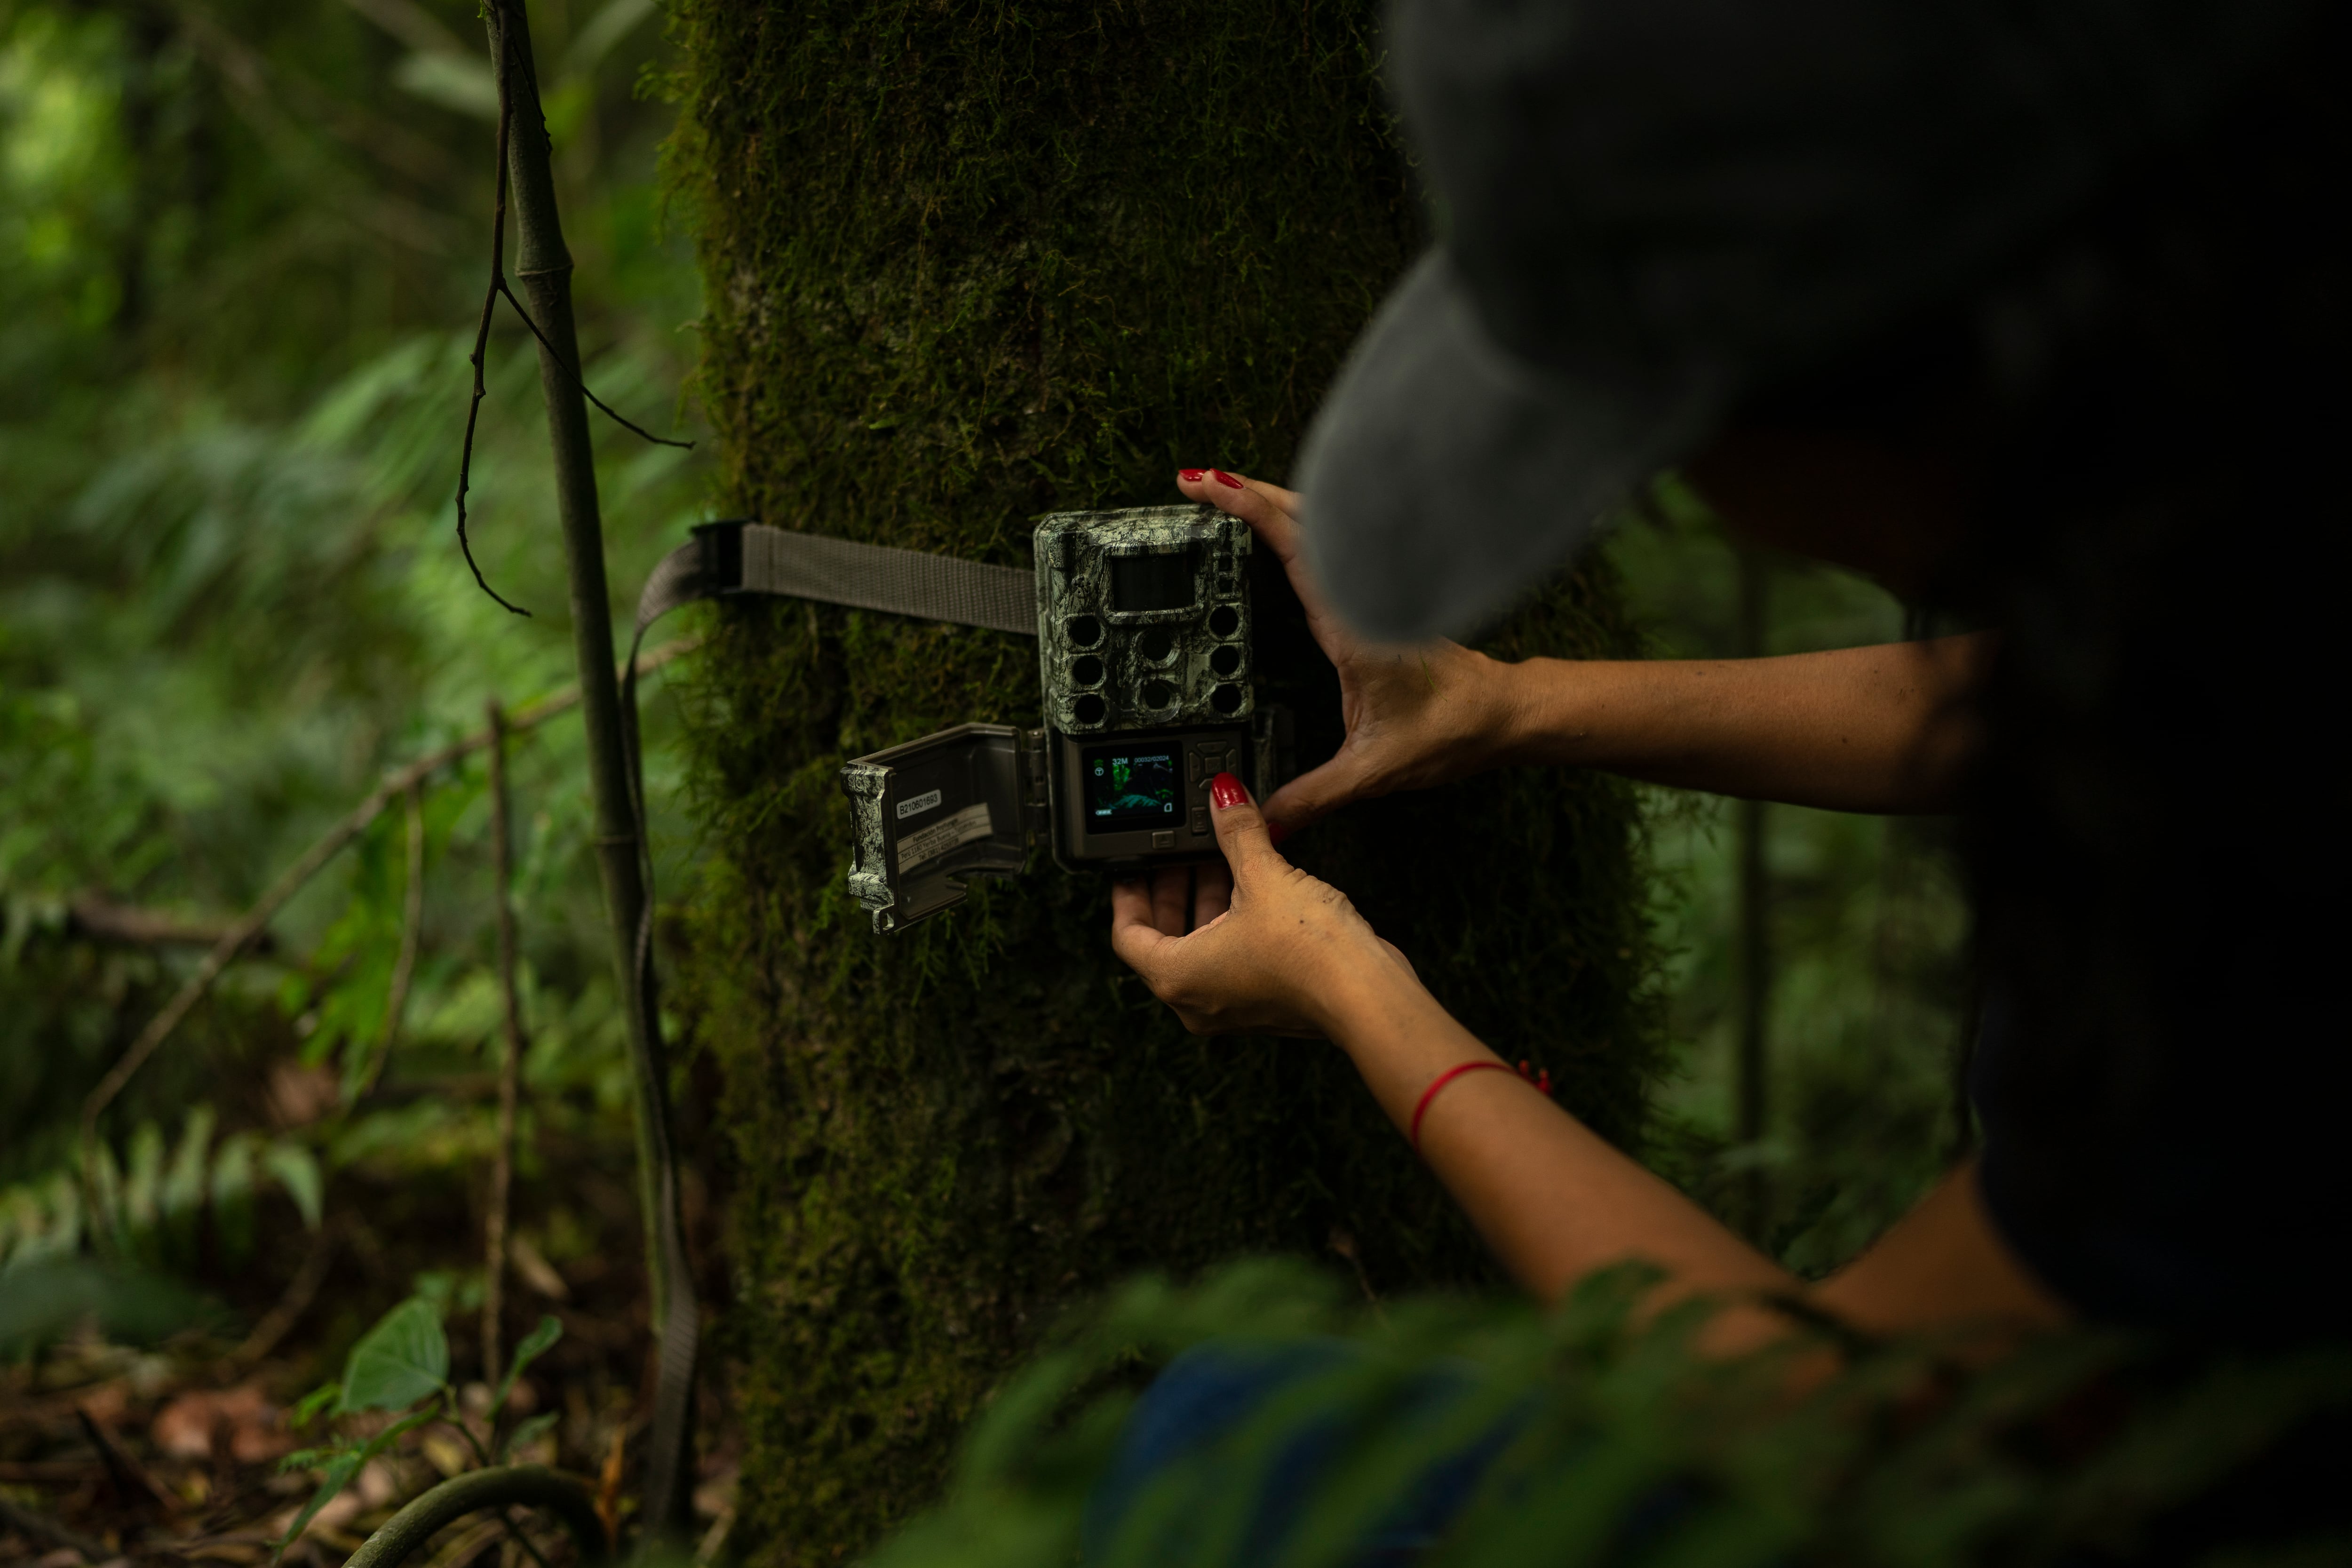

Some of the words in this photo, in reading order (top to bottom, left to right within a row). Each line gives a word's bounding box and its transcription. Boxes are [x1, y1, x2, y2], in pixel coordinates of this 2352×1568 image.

[1112, 756, 1128, 765] 32M
[900, 794, 938, 815] B210601693
[913, 828, 936, 843] Fundación
[901, 850, 911, 860] Perú
[912, 844, 922, 854] 1180
[922, 839, 936, 848] Yerba
